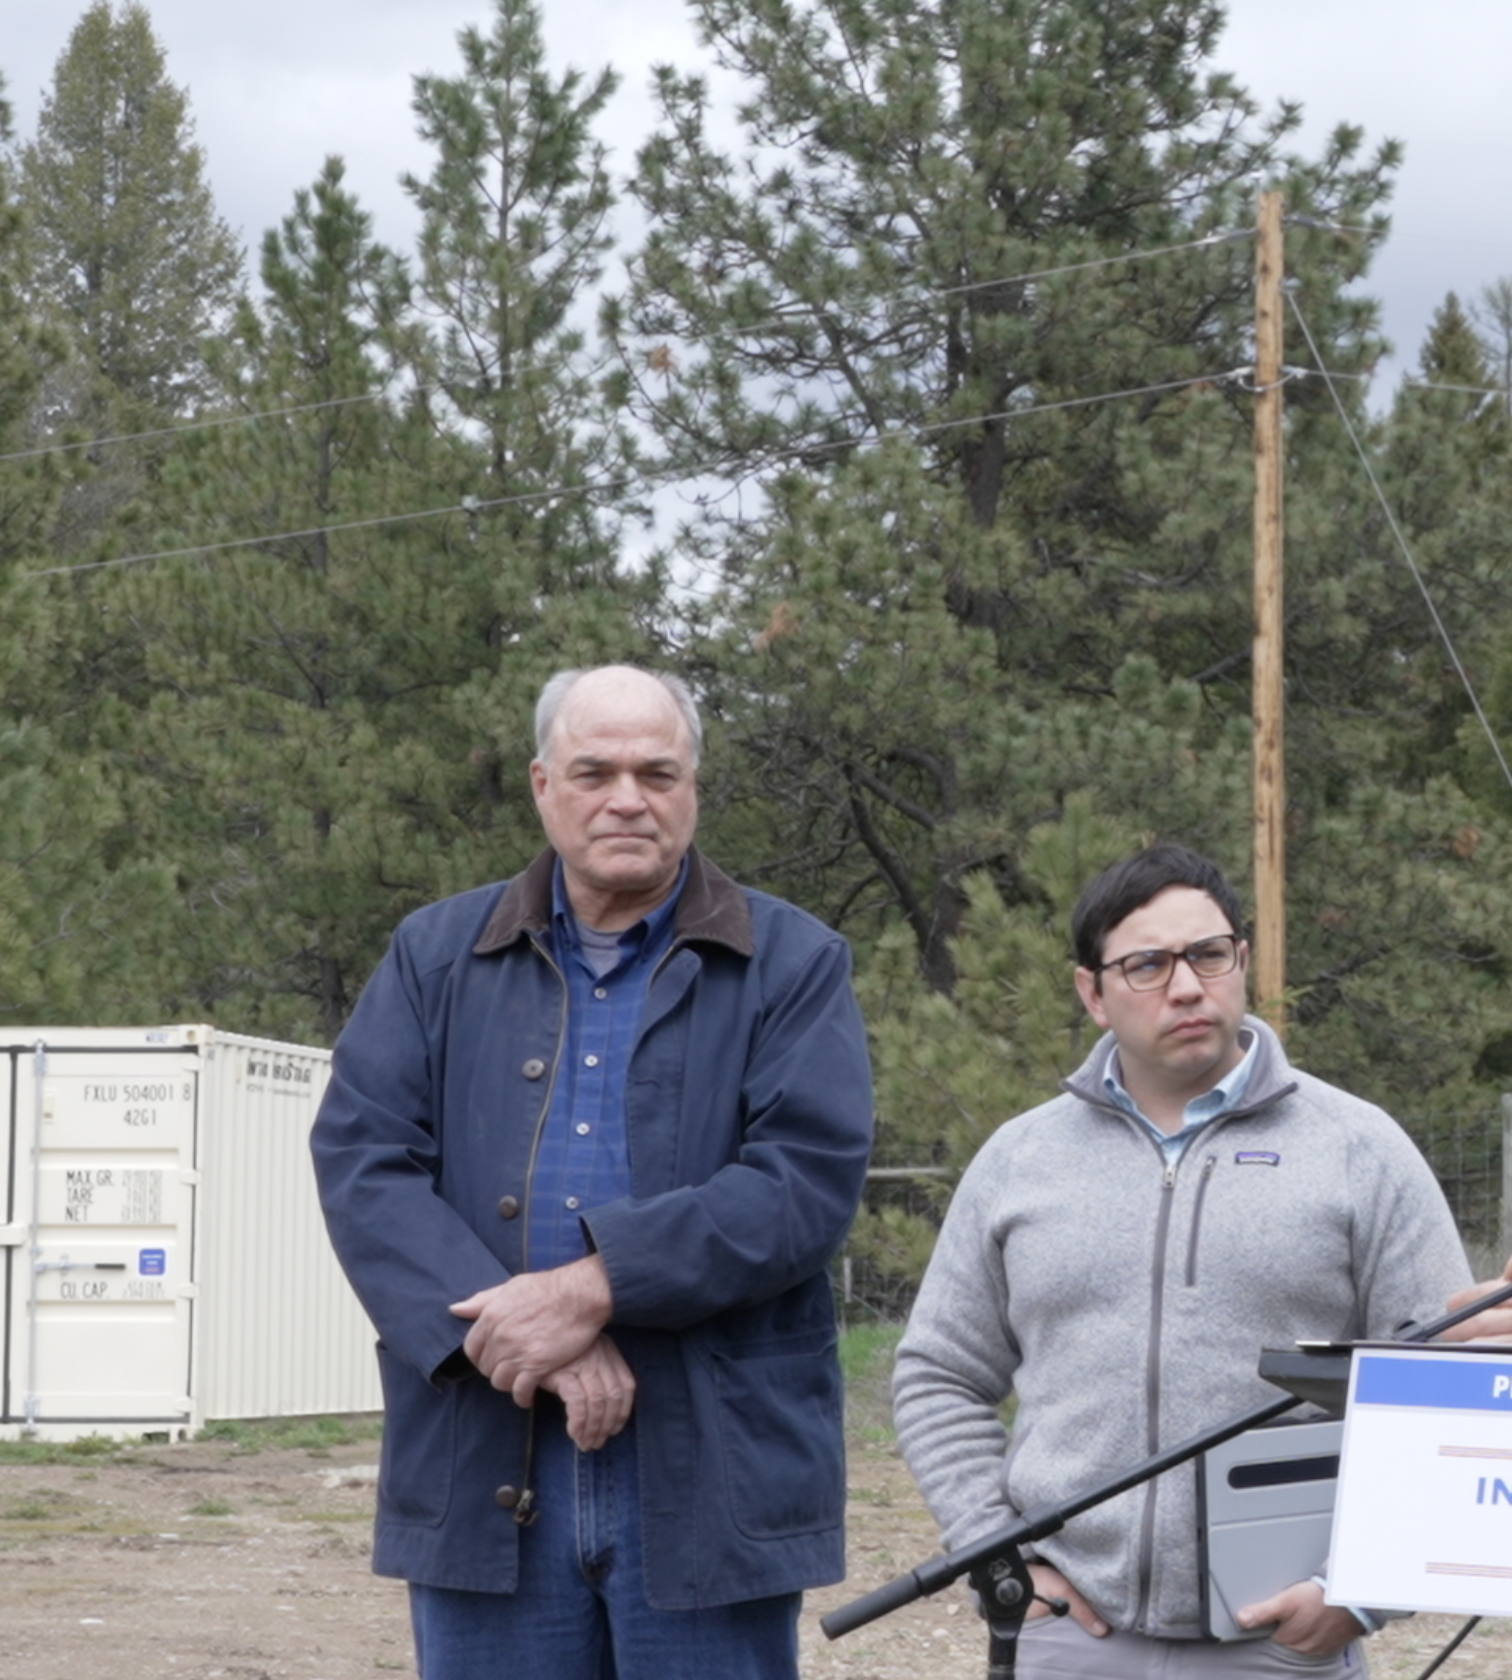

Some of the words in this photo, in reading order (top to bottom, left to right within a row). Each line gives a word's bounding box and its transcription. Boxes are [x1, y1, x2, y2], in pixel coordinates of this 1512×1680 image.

[83, 1084, 118, 1102] FXLU
[123, 1084, 174, 1102] 504001
[182, 1082, 191, 1102] 8
[122, 1108, 157, 1126] 42G1
[65, 1204, 89, 1222] NET
